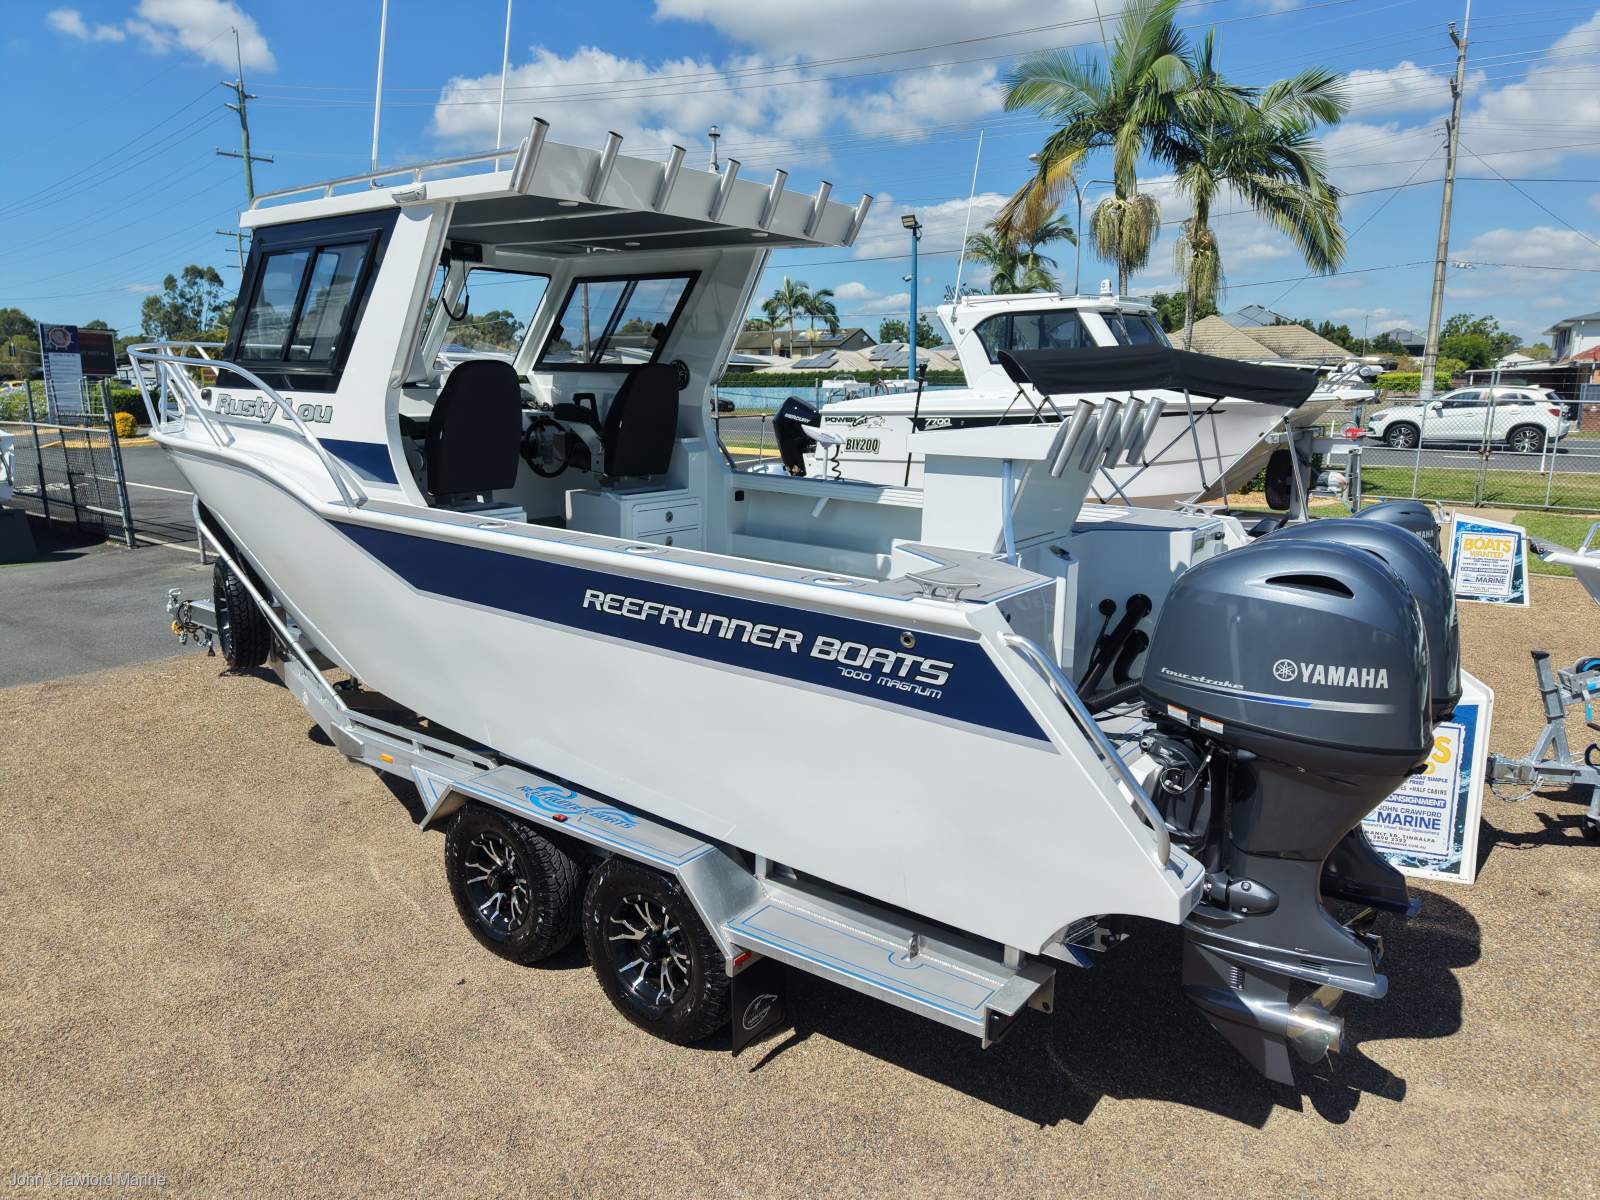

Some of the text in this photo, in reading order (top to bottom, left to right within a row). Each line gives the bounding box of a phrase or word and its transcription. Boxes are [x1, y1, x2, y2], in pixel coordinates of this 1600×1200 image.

[215, 393, 278, 424] Rusty
[1463, 537, 1512, 553] BOATS
[1470, 550, 1505, 559] WANTED
[1475, 576, 1506, 585] MARINE
[582, 588, 954, 686] REEFRUNNER BOATS
[837, 665, 943, 699] 7000 MAGNUM
[1300, 662, 1389, 689] YAMAHA
[1376, 811, 1441, 830] MARINE
[1377, 805, 1442, 818] JOHN CRAWFORD
